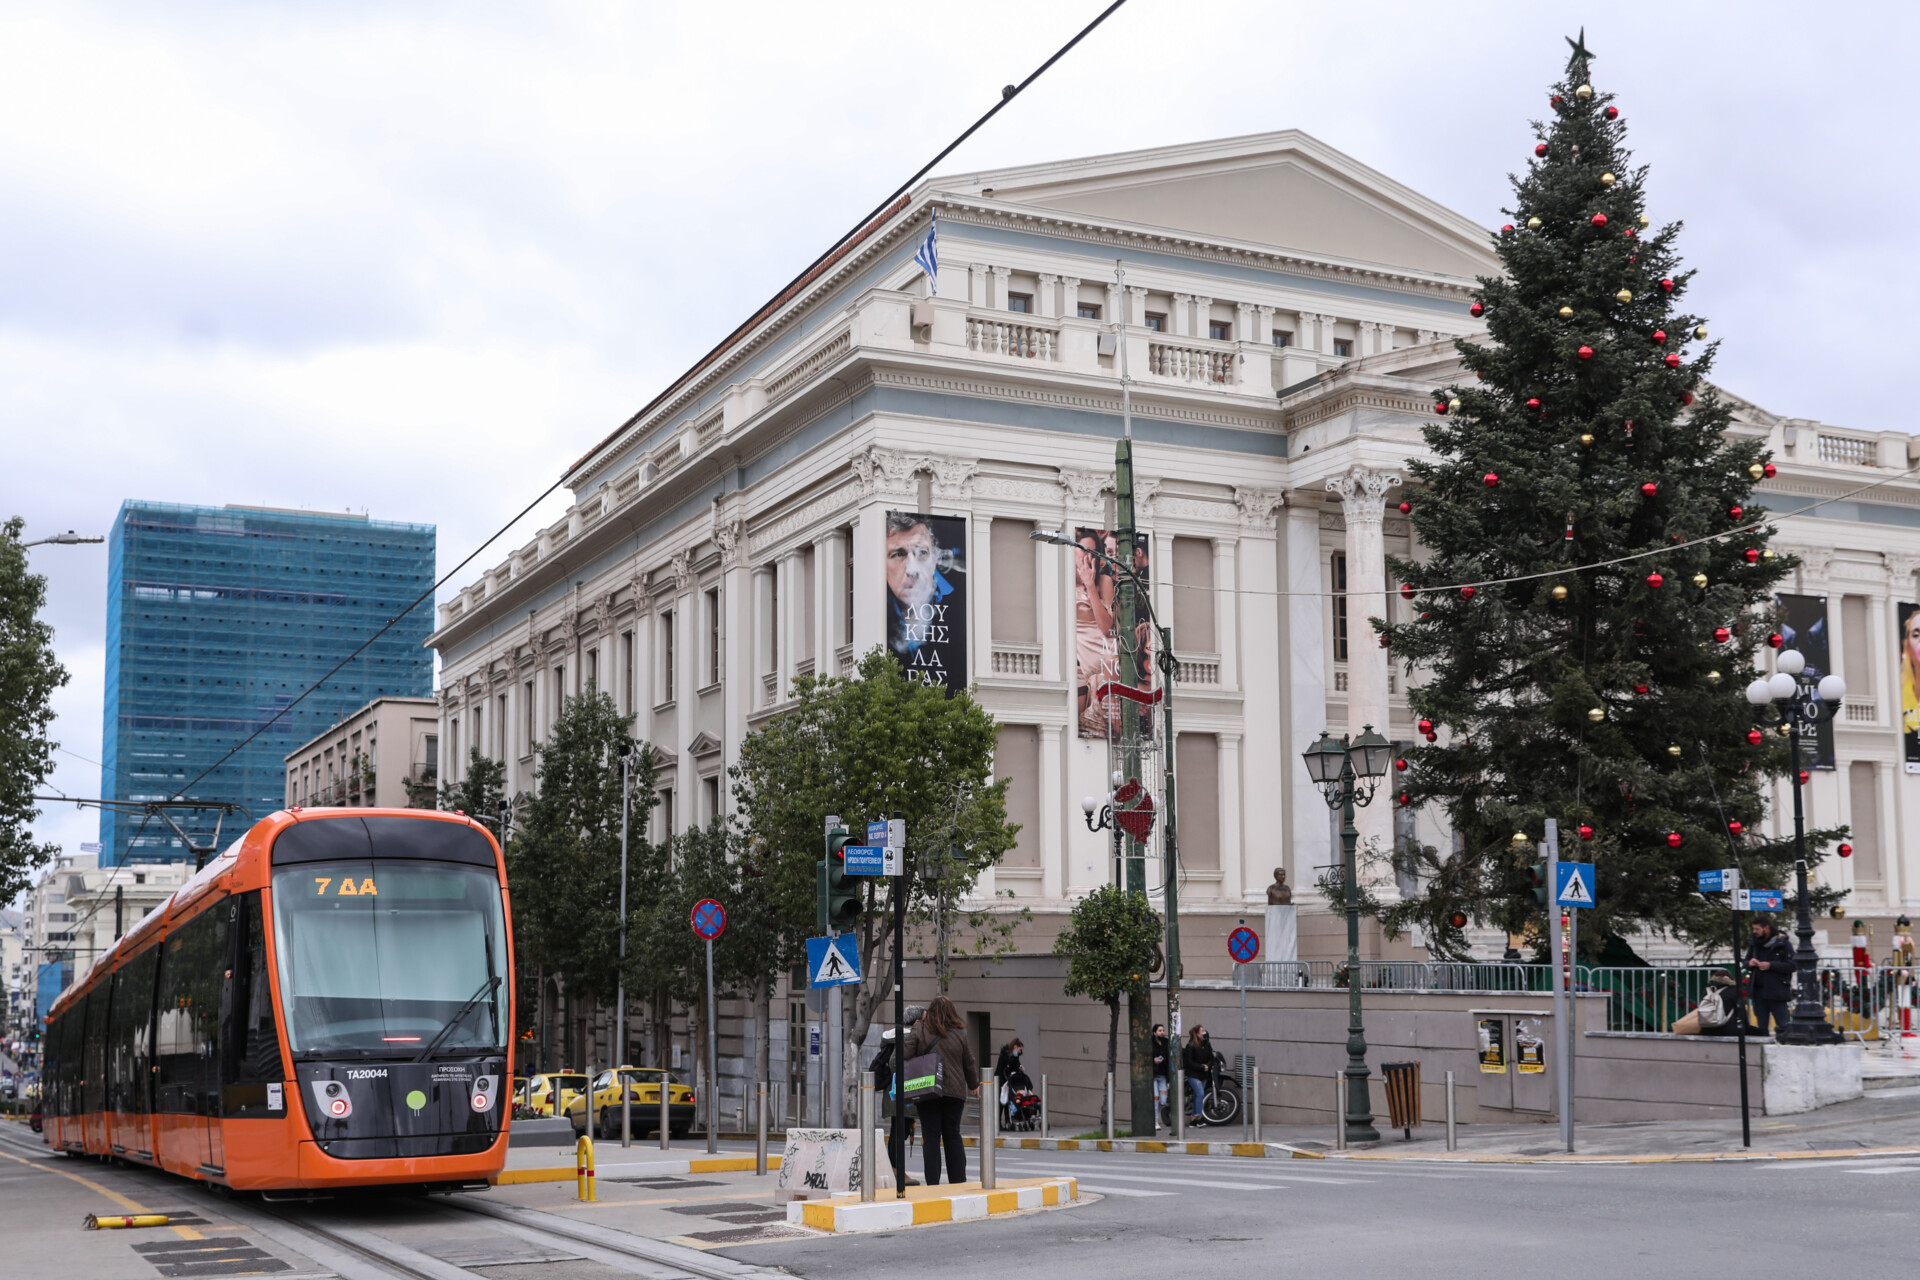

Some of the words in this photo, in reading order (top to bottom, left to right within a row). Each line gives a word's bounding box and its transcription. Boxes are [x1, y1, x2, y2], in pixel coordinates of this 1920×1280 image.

[905, 603, 949, 622] ΛΟΥ
[905, 623, 949, 643] ΚΗΣ
[911, 648, 943, 667] ΛΑ
[315, 878, 332, 895] 7
[338, 878, 378, 896] ΔΑ
[347, 1068, 388, 1080] TA20044
